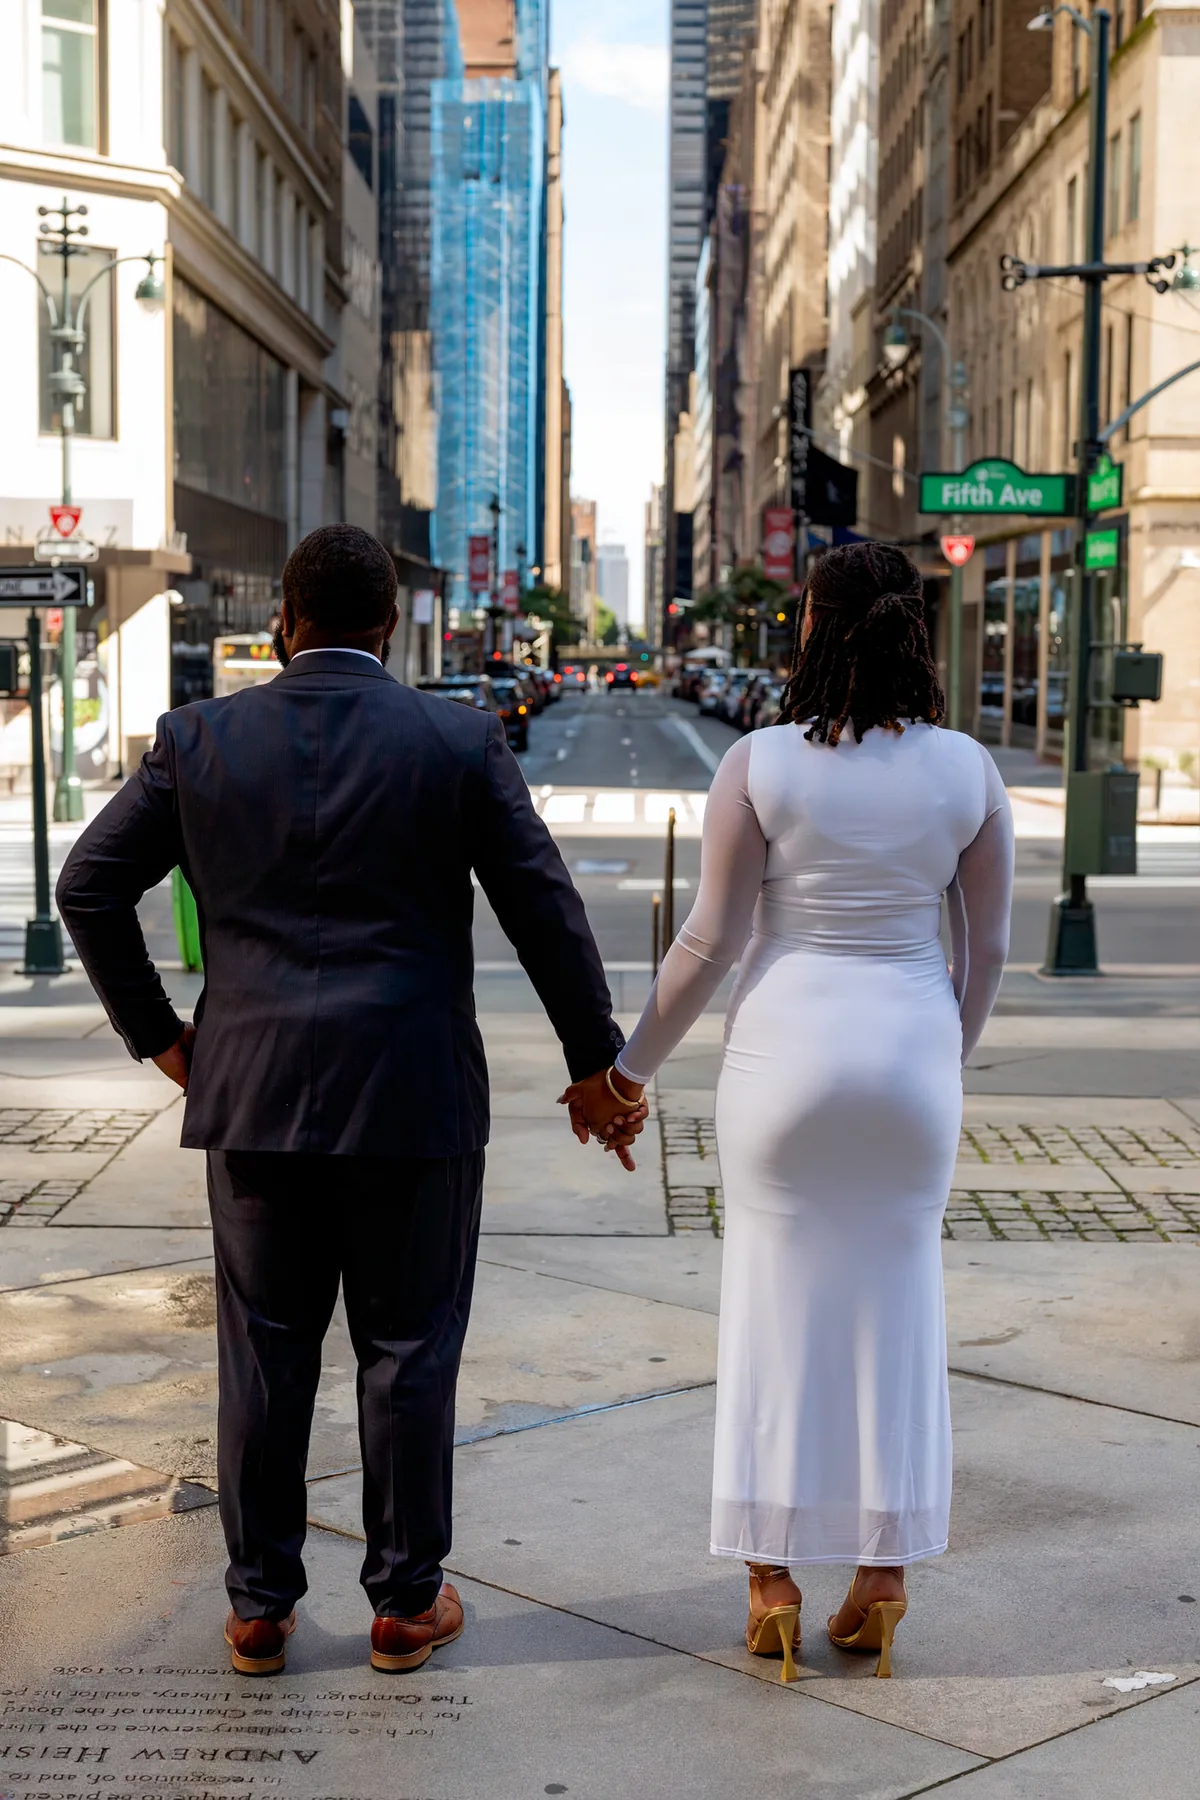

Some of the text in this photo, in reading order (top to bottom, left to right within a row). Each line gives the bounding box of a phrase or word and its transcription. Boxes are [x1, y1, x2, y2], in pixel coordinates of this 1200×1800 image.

[942, 482, 1044, 507] Fifth Ave
[52, 1666, 104, 1676] 1986
[33, 1690, 62, 1699] his
[69, 1690, 98, 1700] for
[104, 1690, 141, 1700] and
[241, 1692, 274, 1702] the
[281, 1693, 306, 1703] for
[316, 1691, 422, 1705] Campaign
[431, 1695, 473, 1705] The
[3, 1706, 65, 1716] Board
[74, 1707, 105, 1716] the
[109, 1708, 135, 1717] of
[142, 1708, 246, 1719] Chairman
[252, 1708, 274, 1716] as
[434, 1712, 461, 1722] for
[56, 1724, 88, 1734] the
[96, 1724, 117, 1732] to
[125, 1724, 208, 1734] service
[404, 1729, 435, 1738] for
[130, 1748, 319, 1765] ANDREW
[38, 1773, 77, 1783] and
[125, 1771, 255, 1785] recognition
